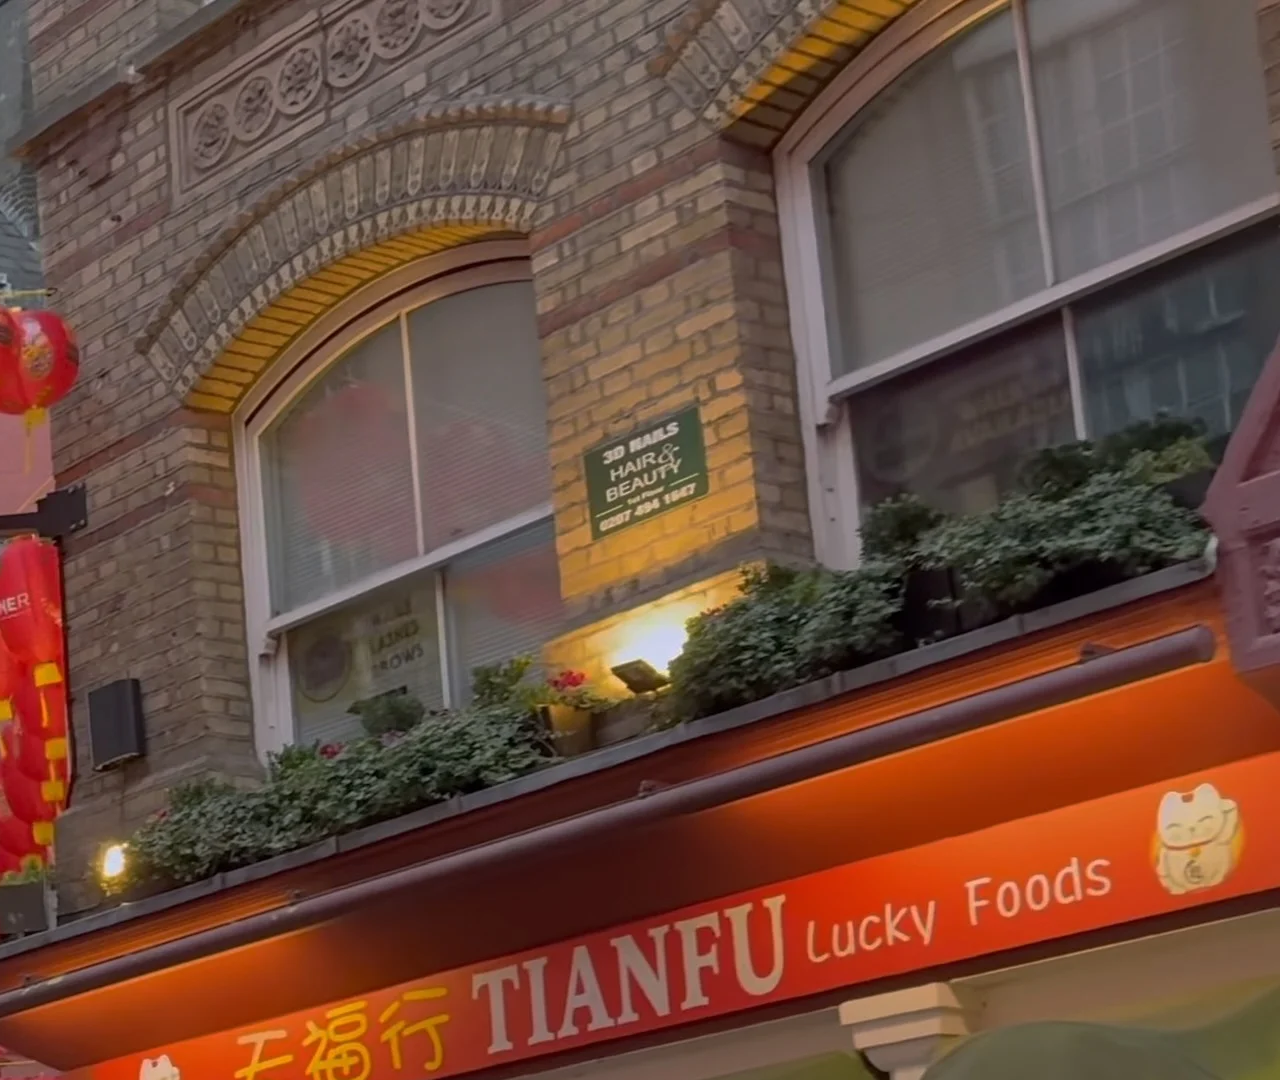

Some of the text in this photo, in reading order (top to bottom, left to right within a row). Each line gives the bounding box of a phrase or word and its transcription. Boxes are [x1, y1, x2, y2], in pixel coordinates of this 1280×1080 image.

[603, 421, 679, 465] 3D NAILS
[610, 443, 680, 482] HAIR &
[605, 458, 682, 502] BEAUTY
[472, 894, 787, 1055] TIANFU
[806, 900, 937, 963] Lucky
[964, 855, 1113, 926] Foods
